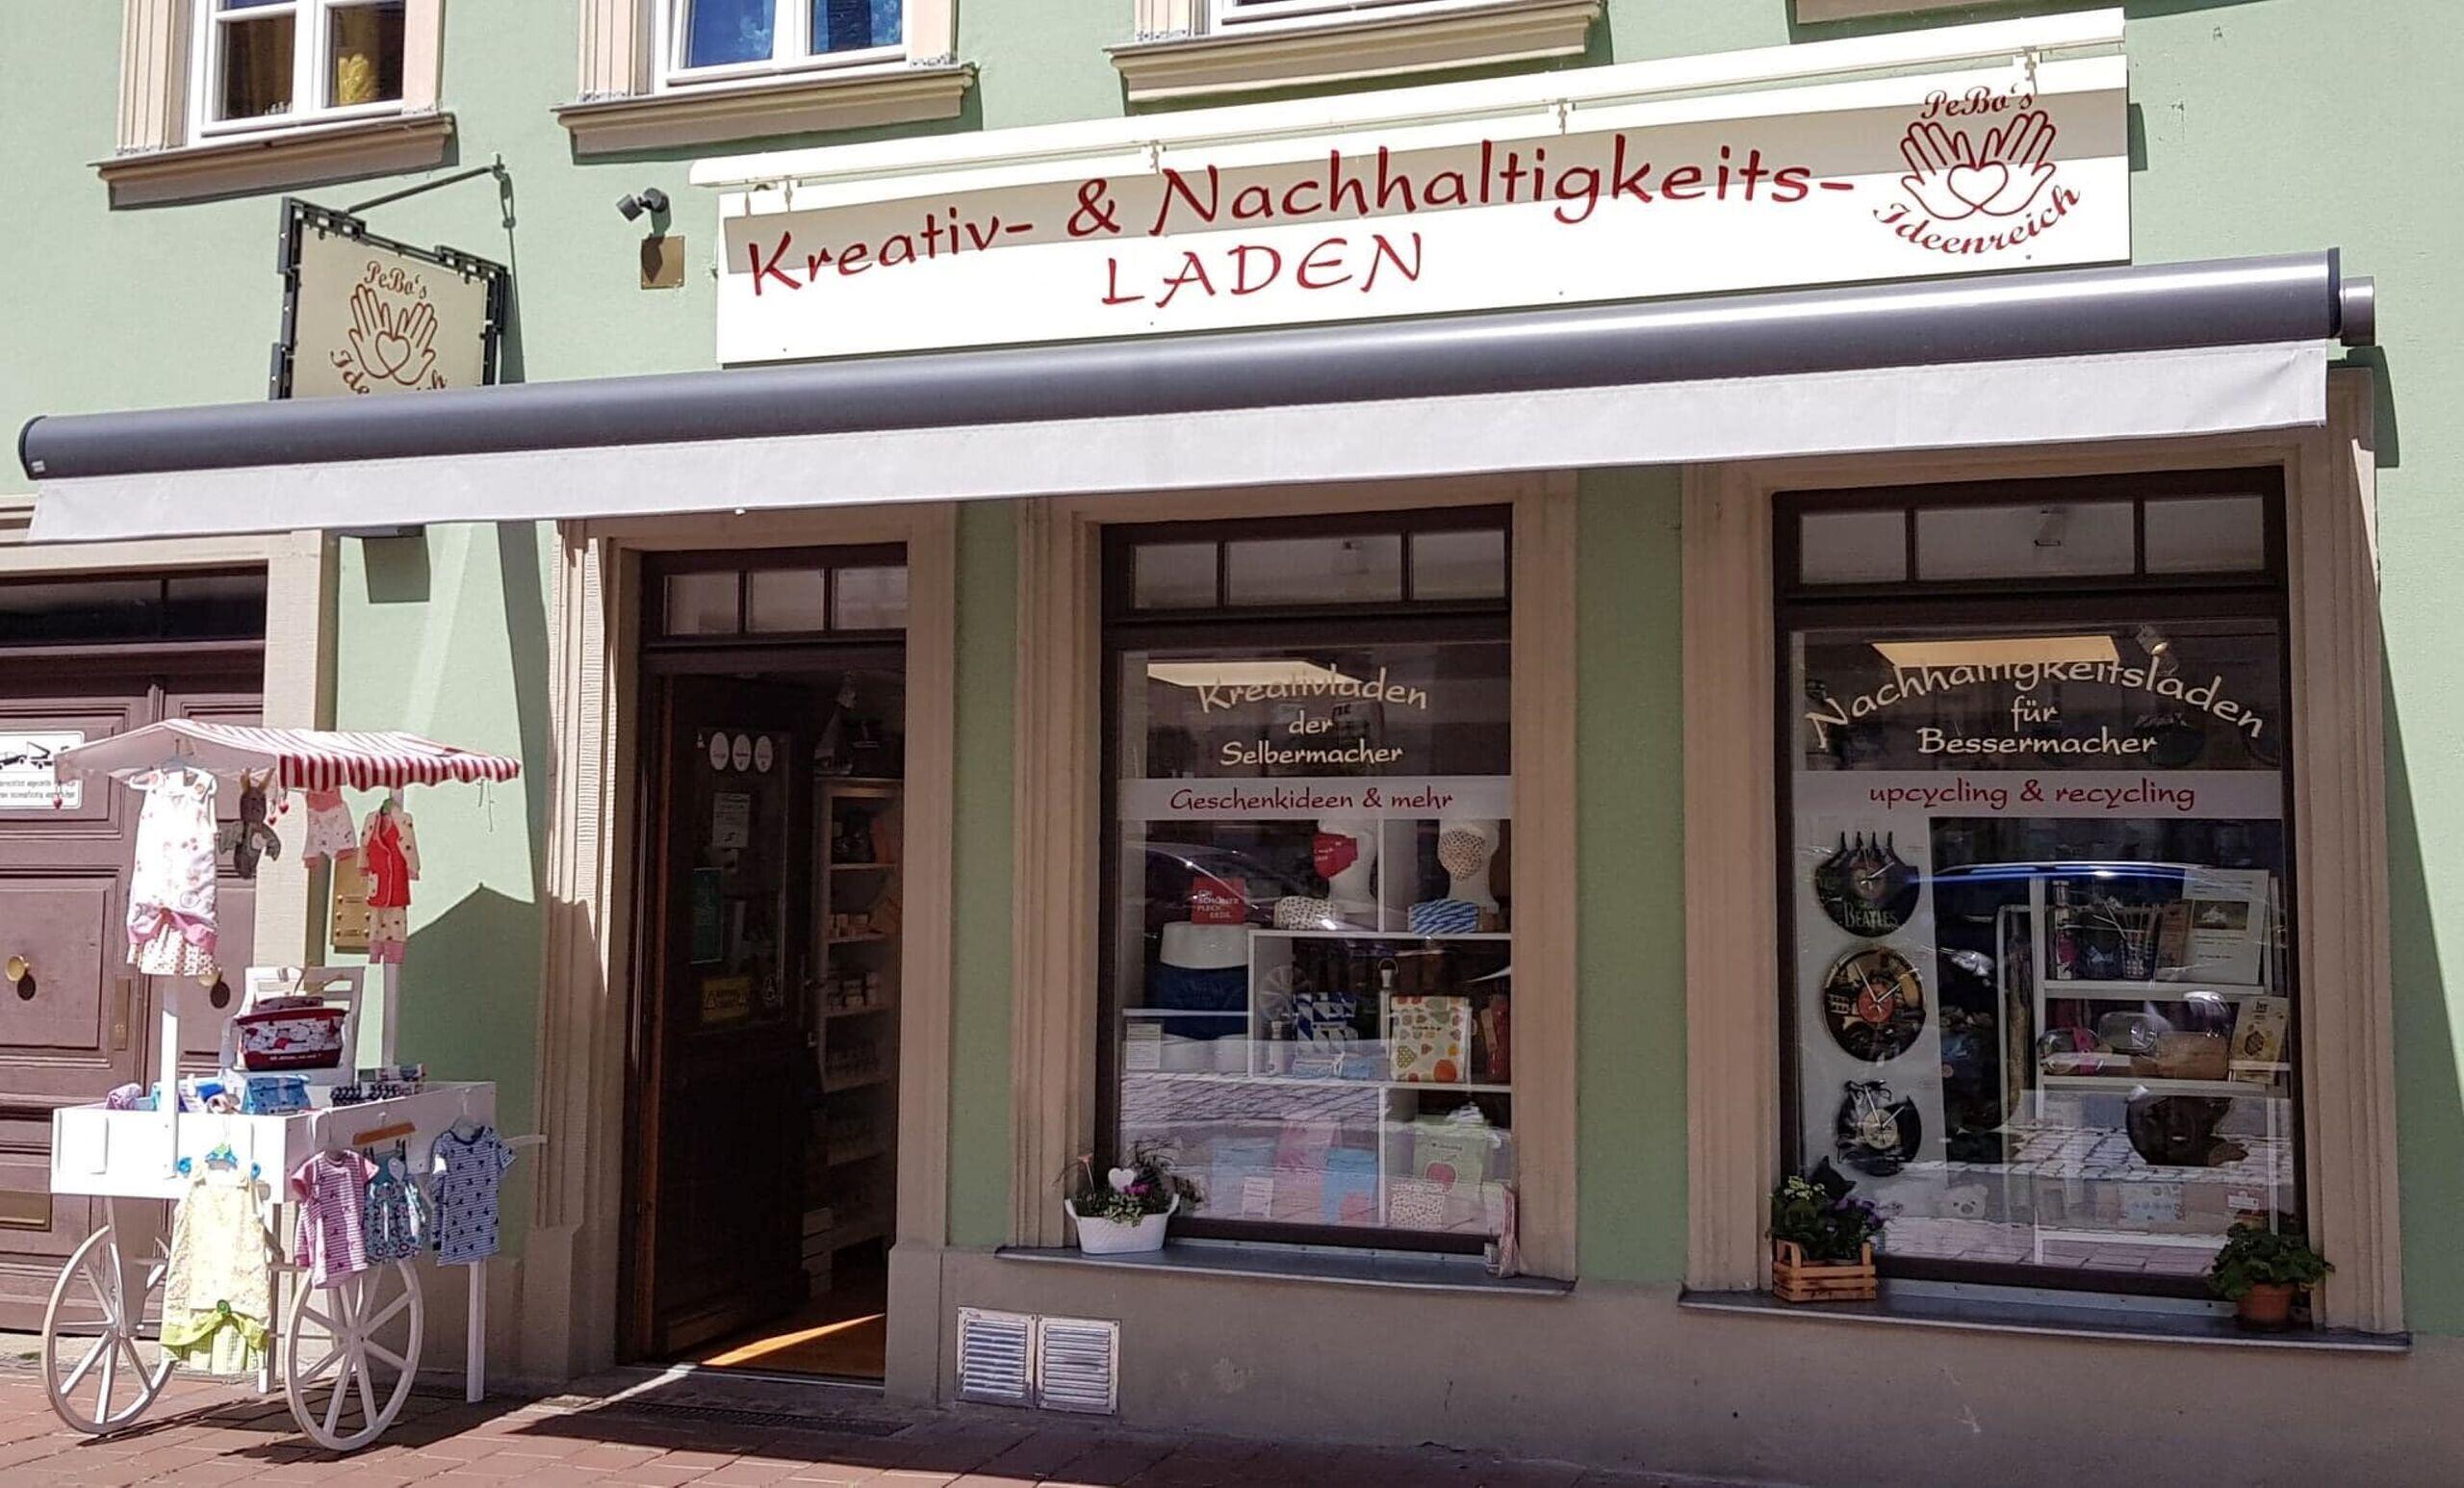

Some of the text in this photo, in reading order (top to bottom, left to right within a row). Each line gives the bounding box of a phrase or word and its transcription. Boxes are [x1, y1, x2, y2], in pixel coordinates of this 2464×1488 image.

[749, 134, 1855, 296] Kreativ- & Nachhaltigkeits-
[1873, 185, 2081, 254] Ideenreich
[1101, 232, 1423, 308] LADEN
[1197, 663, 1428, 714] Kreativladen
[1805, 654, 2265, 750] Nachhaltigkeitsladen
[1288, 710, 1333, 735] der
[2011, 695, 2060, 732] für
[1219, 738, 1404, 766] Selbermacher
[1916, 726, 2158, 756] Bessermacher
[1169, 784, 1454, 810] Geschenkideen & mehr
[1869, 777, 2197, 810] upcycling & recycling
